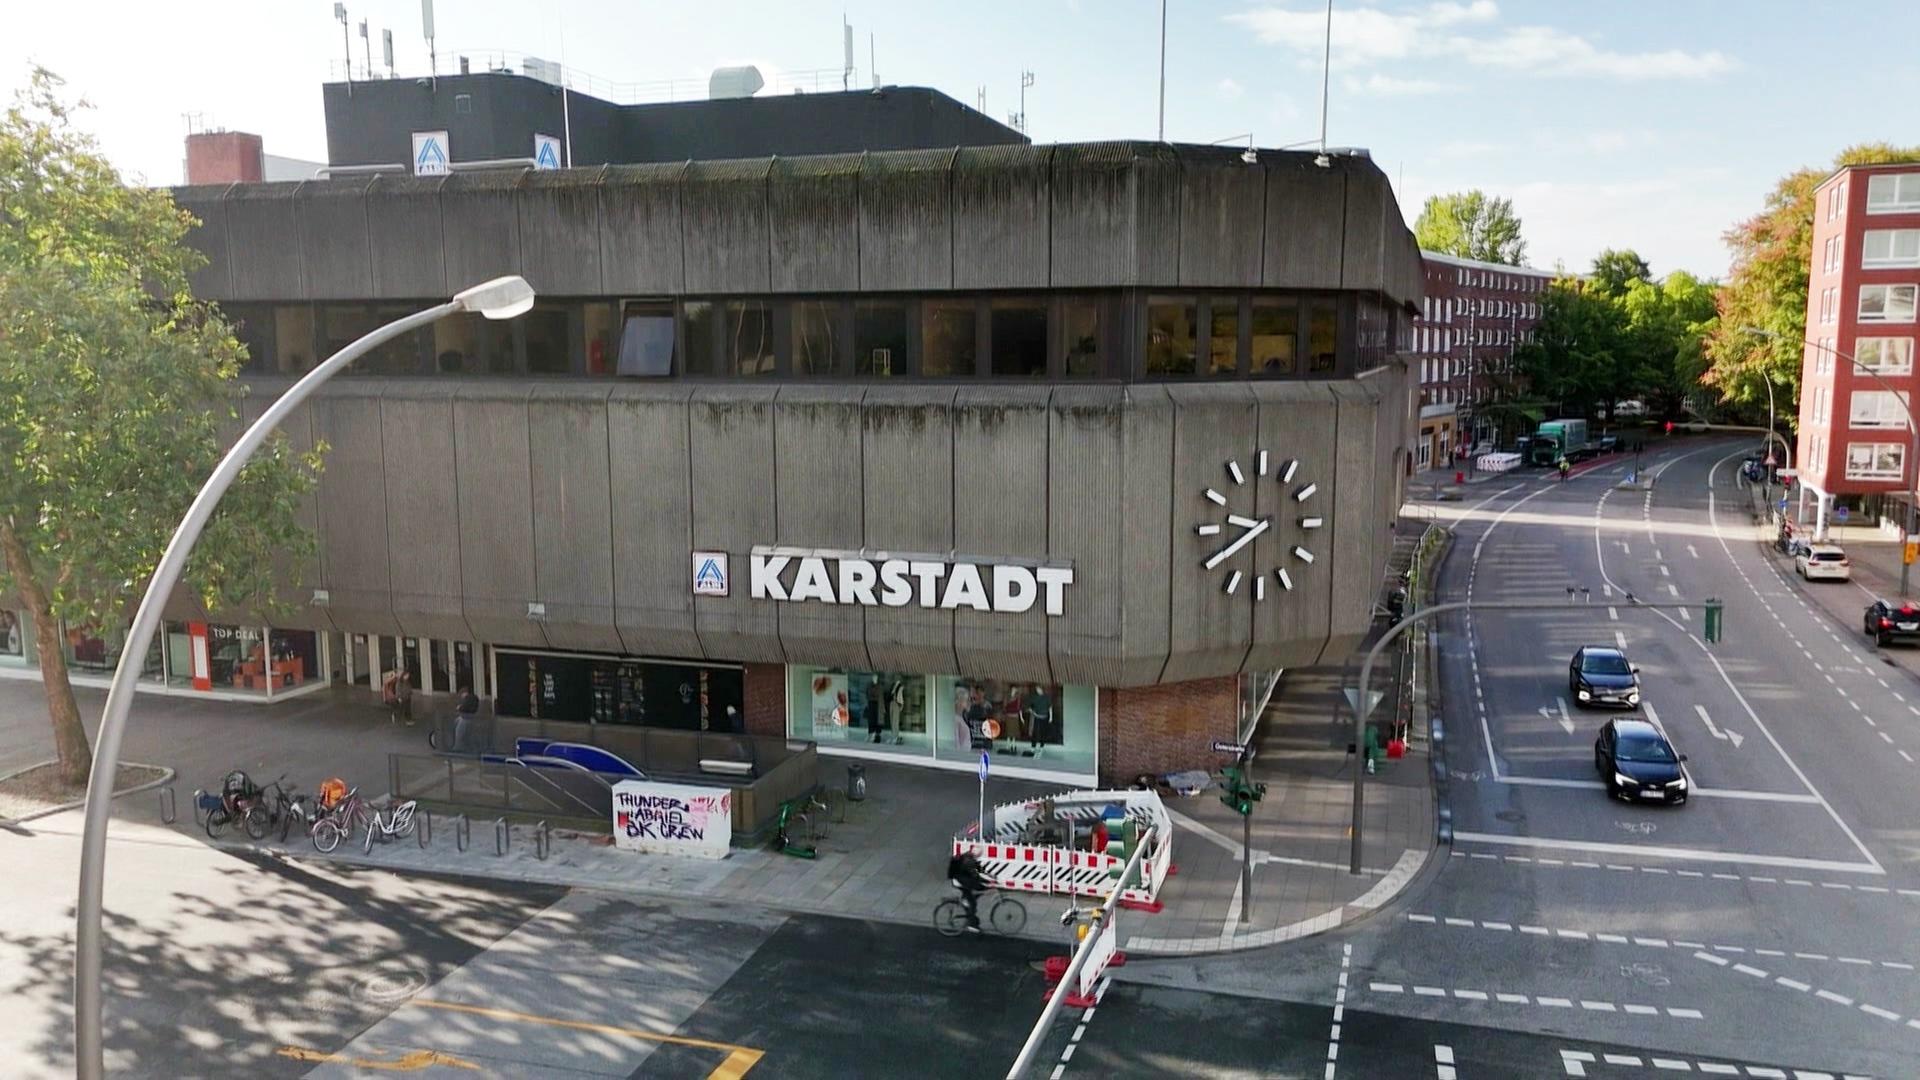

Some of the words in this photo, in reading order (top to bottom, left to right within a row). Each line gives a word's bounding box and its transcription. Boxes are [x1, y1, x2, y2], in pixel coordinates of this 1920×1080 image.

[750, 553, 1073, 615] KARSTADT
[213, 628, 232, 638] TOP
[235, 629, 260, 641] DEAL
[660, 822, 703, 840] CREW
